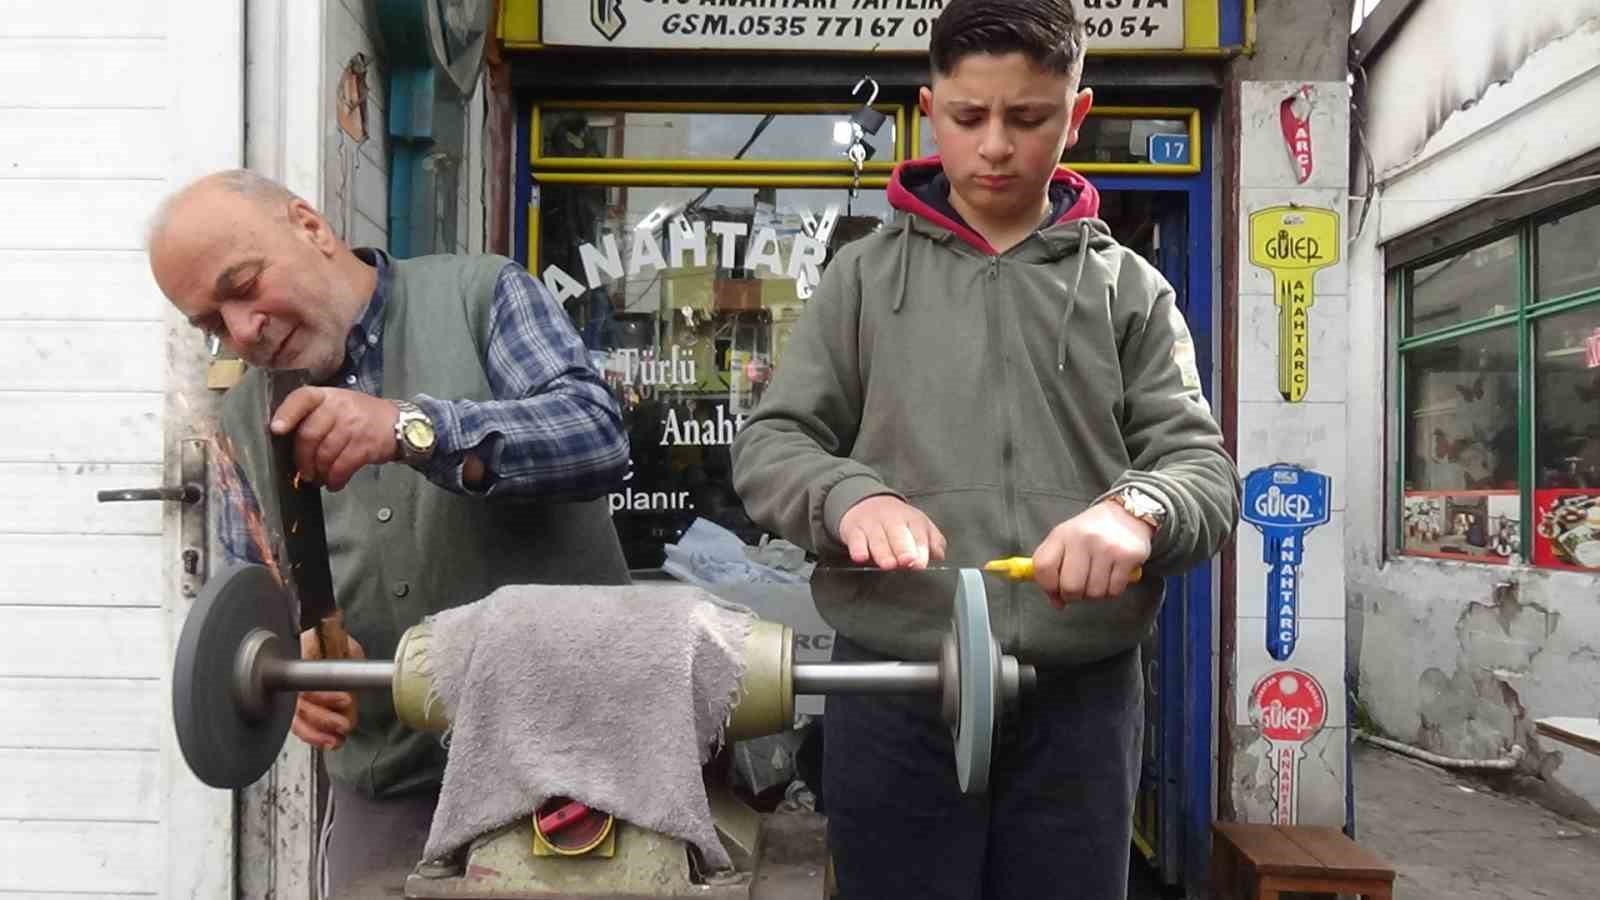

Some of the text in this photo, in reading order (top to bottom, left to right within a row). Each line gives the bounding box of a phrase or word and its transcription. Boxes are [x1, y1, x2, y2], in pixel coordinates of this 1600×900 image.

[662, 13, 806, 36] GSM.0535
[912, 17, 937, 37] 0
[1164, 141, 1185, 159] 17
[1293, 280, 1305, 397] ANAHTARCI
[617, 344, 697, 386] Türlü
[1279, 535, 1295, 655] ANAHTARCI
